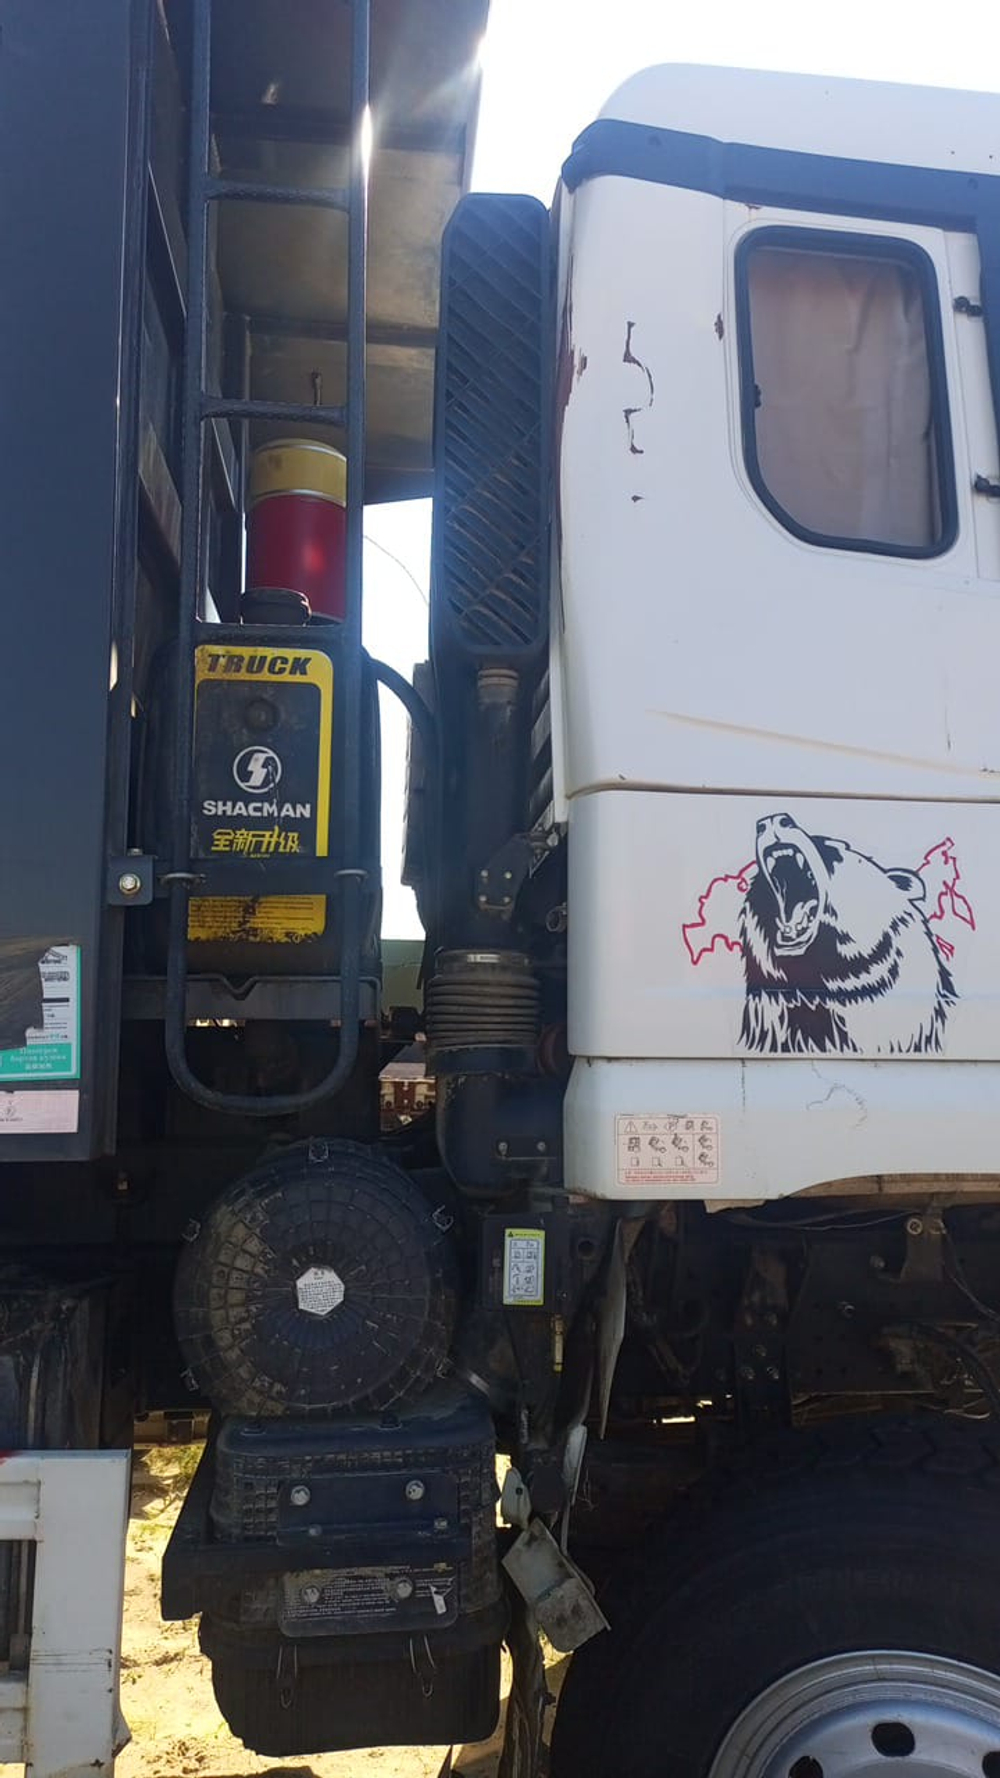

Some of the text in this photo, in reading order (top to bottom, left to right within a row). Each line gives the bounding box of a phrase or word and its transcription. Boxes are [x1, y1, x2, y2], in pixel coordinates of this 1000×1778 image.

[208, 654, 312, 676] TRUCK
[202, 799, 311, 818] SHACMAN
[211, 825, 300, 853] 全新升级
